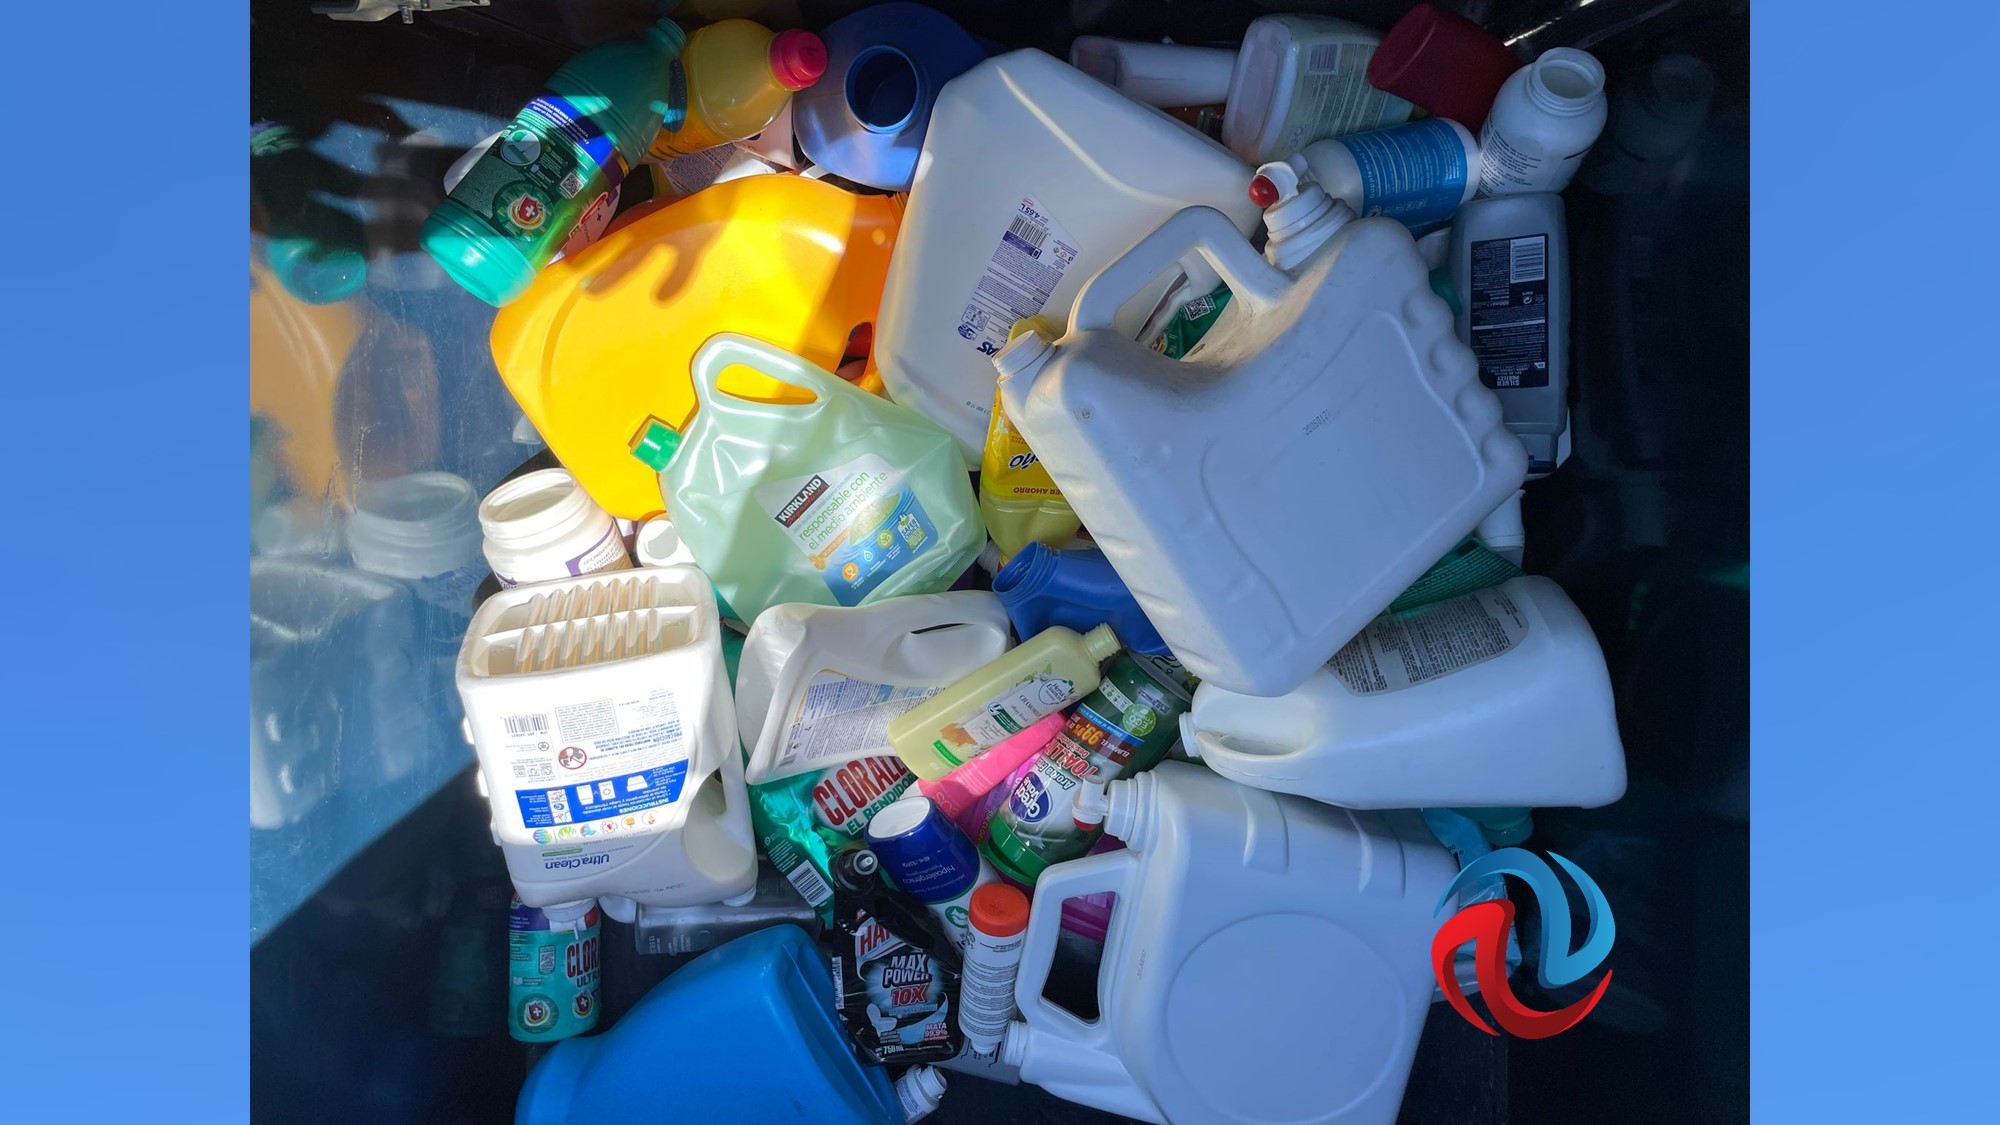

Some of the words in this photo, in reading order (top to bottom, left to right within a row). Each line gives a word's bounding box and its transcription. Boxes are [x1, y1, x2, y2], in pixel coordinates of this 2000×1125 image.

[1360, 151, 1376, 199] Supplement
[1024, 206, 1041, 219] 4.65
[975, 338, 999, 358] AS
[776, 477, 823, 522] KIRKLAND
[796, 486, 853, 542] responsable
[848, 470, 870, 492] con
[805, 536, 819, 551] el
[814, 510, 846, 542] medio
[841, 469, 888, 516] ambiente
[900, 518, 918, 535] SAFER
[903, 523, 921, 540] CHOICE
[1071, 718, 1103, 747] 99.9%
[1127, 712, 1148, 730] ECO
[1106, 740, 1129, 760] ELIMINA
[1018, 775, 1044, 800] Value
[1043, 763, 1076, 793] Aroma
[813, 755, 910, 828] CLORALE
[865, 772, 918, 821] RENDIDOR
[1007, 784, 1046, 820] Great
[618, 797, 669, 813] INSTRUCCIONES
[845, 815, 866, 835] EL
[566, 936, 598, 978] CLOR
[890, 952, 926, 971] MAX
[884, 968, 929, 987] POWER
[891, 981, 928, 1008] 10X
[926, 1022, 946, 1030] MATA
